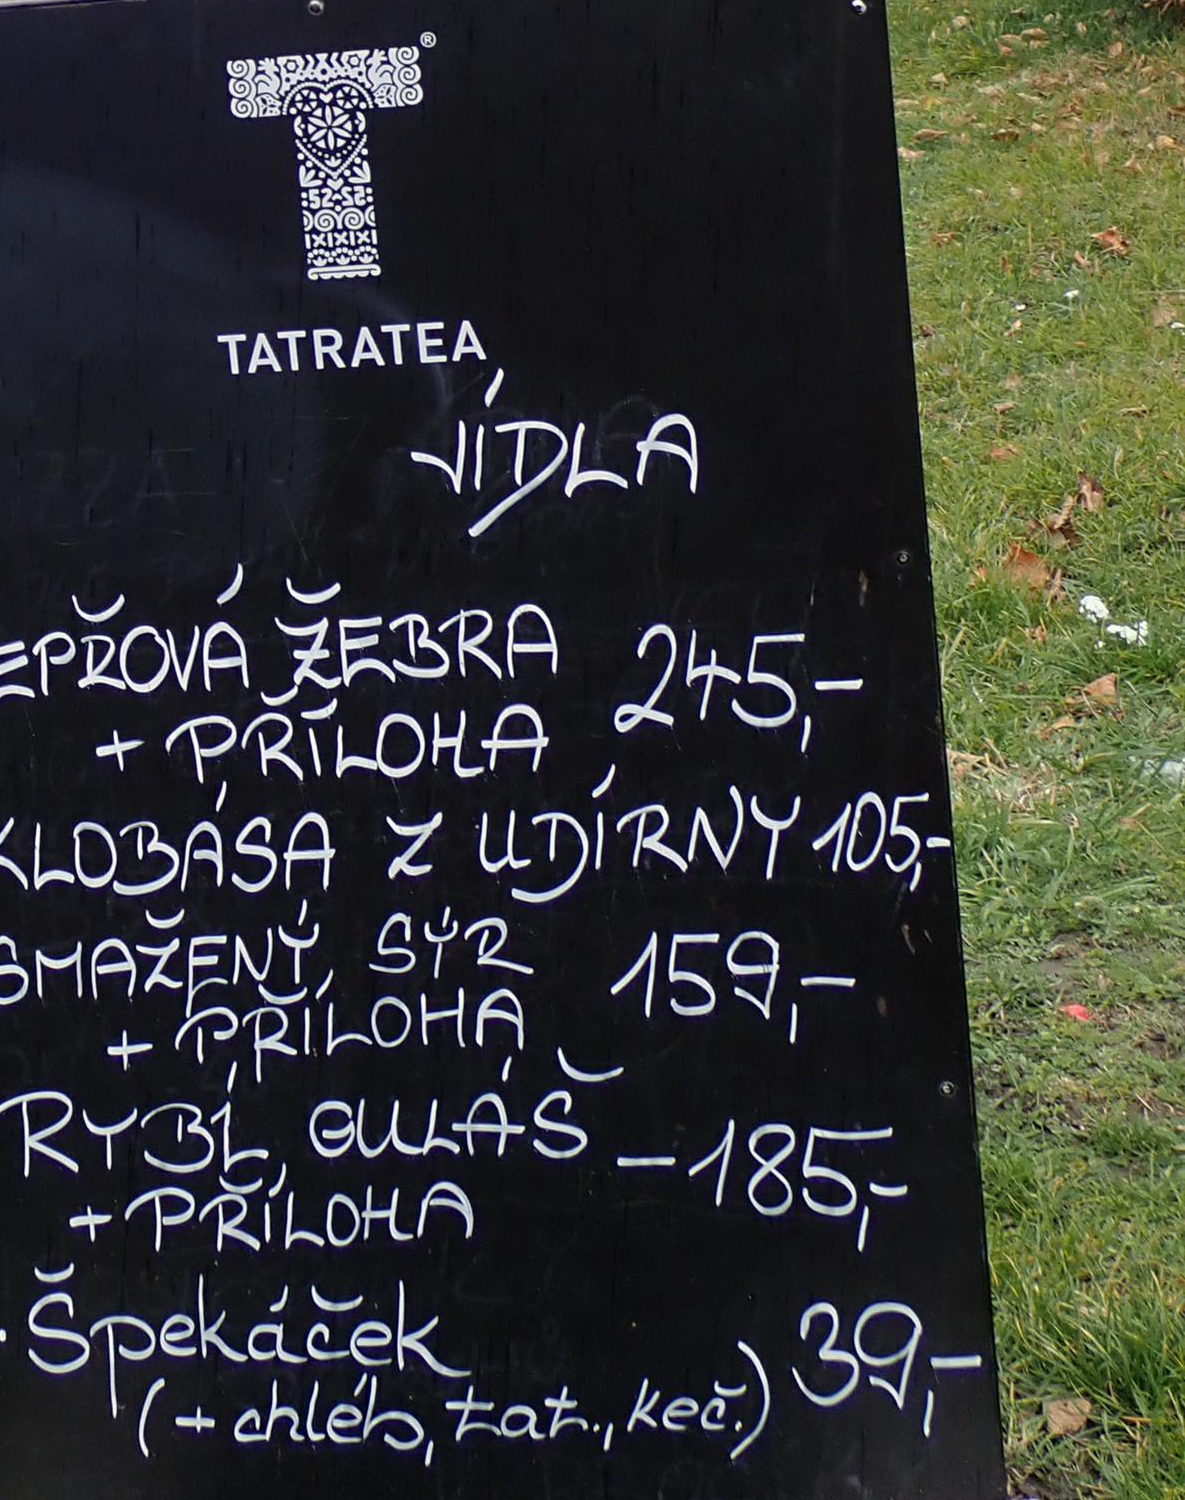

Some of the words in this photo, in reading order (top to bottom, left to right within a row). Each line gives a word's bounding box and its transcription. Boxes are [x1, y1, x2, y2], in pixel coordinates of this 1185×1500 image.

[217, 320, 487, 375] TATRATEA
[411, 368, 699, 538] JÍDLA
[275, 578, 559, 688] ŽEBRA
[613, 624, 864, 753] 245,-
[166, 686, 551, 784] PŘÍLOHA
[386, 812, 443, 880] Z
[479, 764, 801, 903] UDÍRNY
[813, 792, 951, 892] 105,-
[175, 969, 524, 1082] PŘÍLOHA
[369, 907, 534, 979] SÝR
[611, 931, 856, 1044] 159,-
[310, 1048, 624, 1159] GULÁŠ
[125, 1163, 474, 1253] PŘÍLOHA
[28, 1263, 471, 1419] Špekáček
[792, 1303, 977, 1438] 39,-
